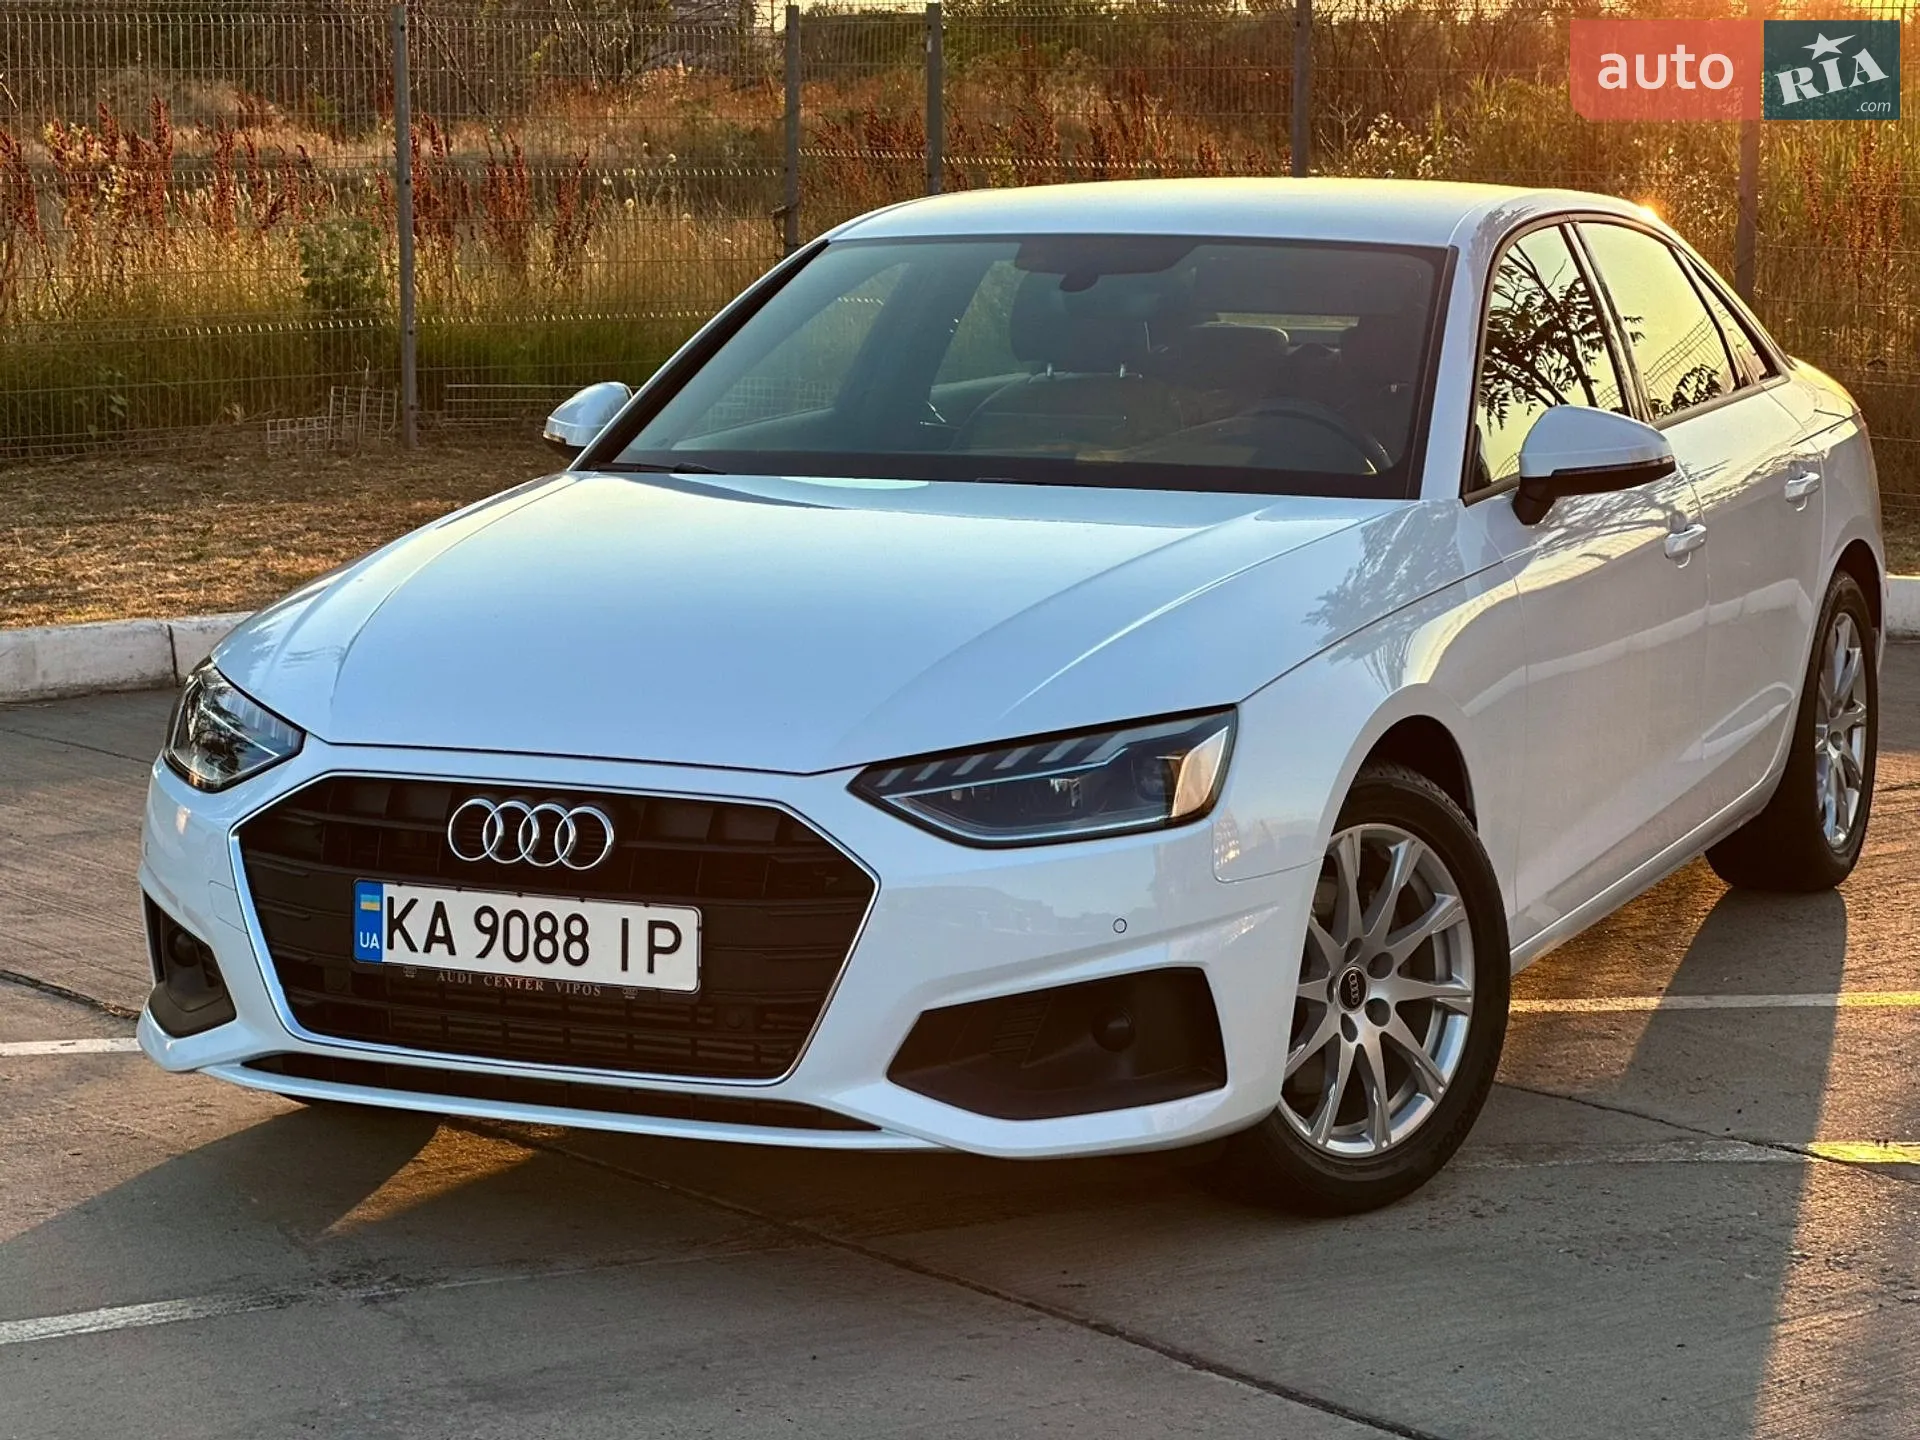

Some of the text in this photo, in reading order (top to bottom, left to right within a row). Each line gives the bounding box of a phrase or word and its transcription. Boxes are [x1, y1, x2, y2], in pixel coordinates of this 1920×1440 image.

[359, 931, 380, 950] UA
[386, 896, 683, 975] KA 9088 IP
[436, 970, 601, 997] AUDI CENTER VIPOS
